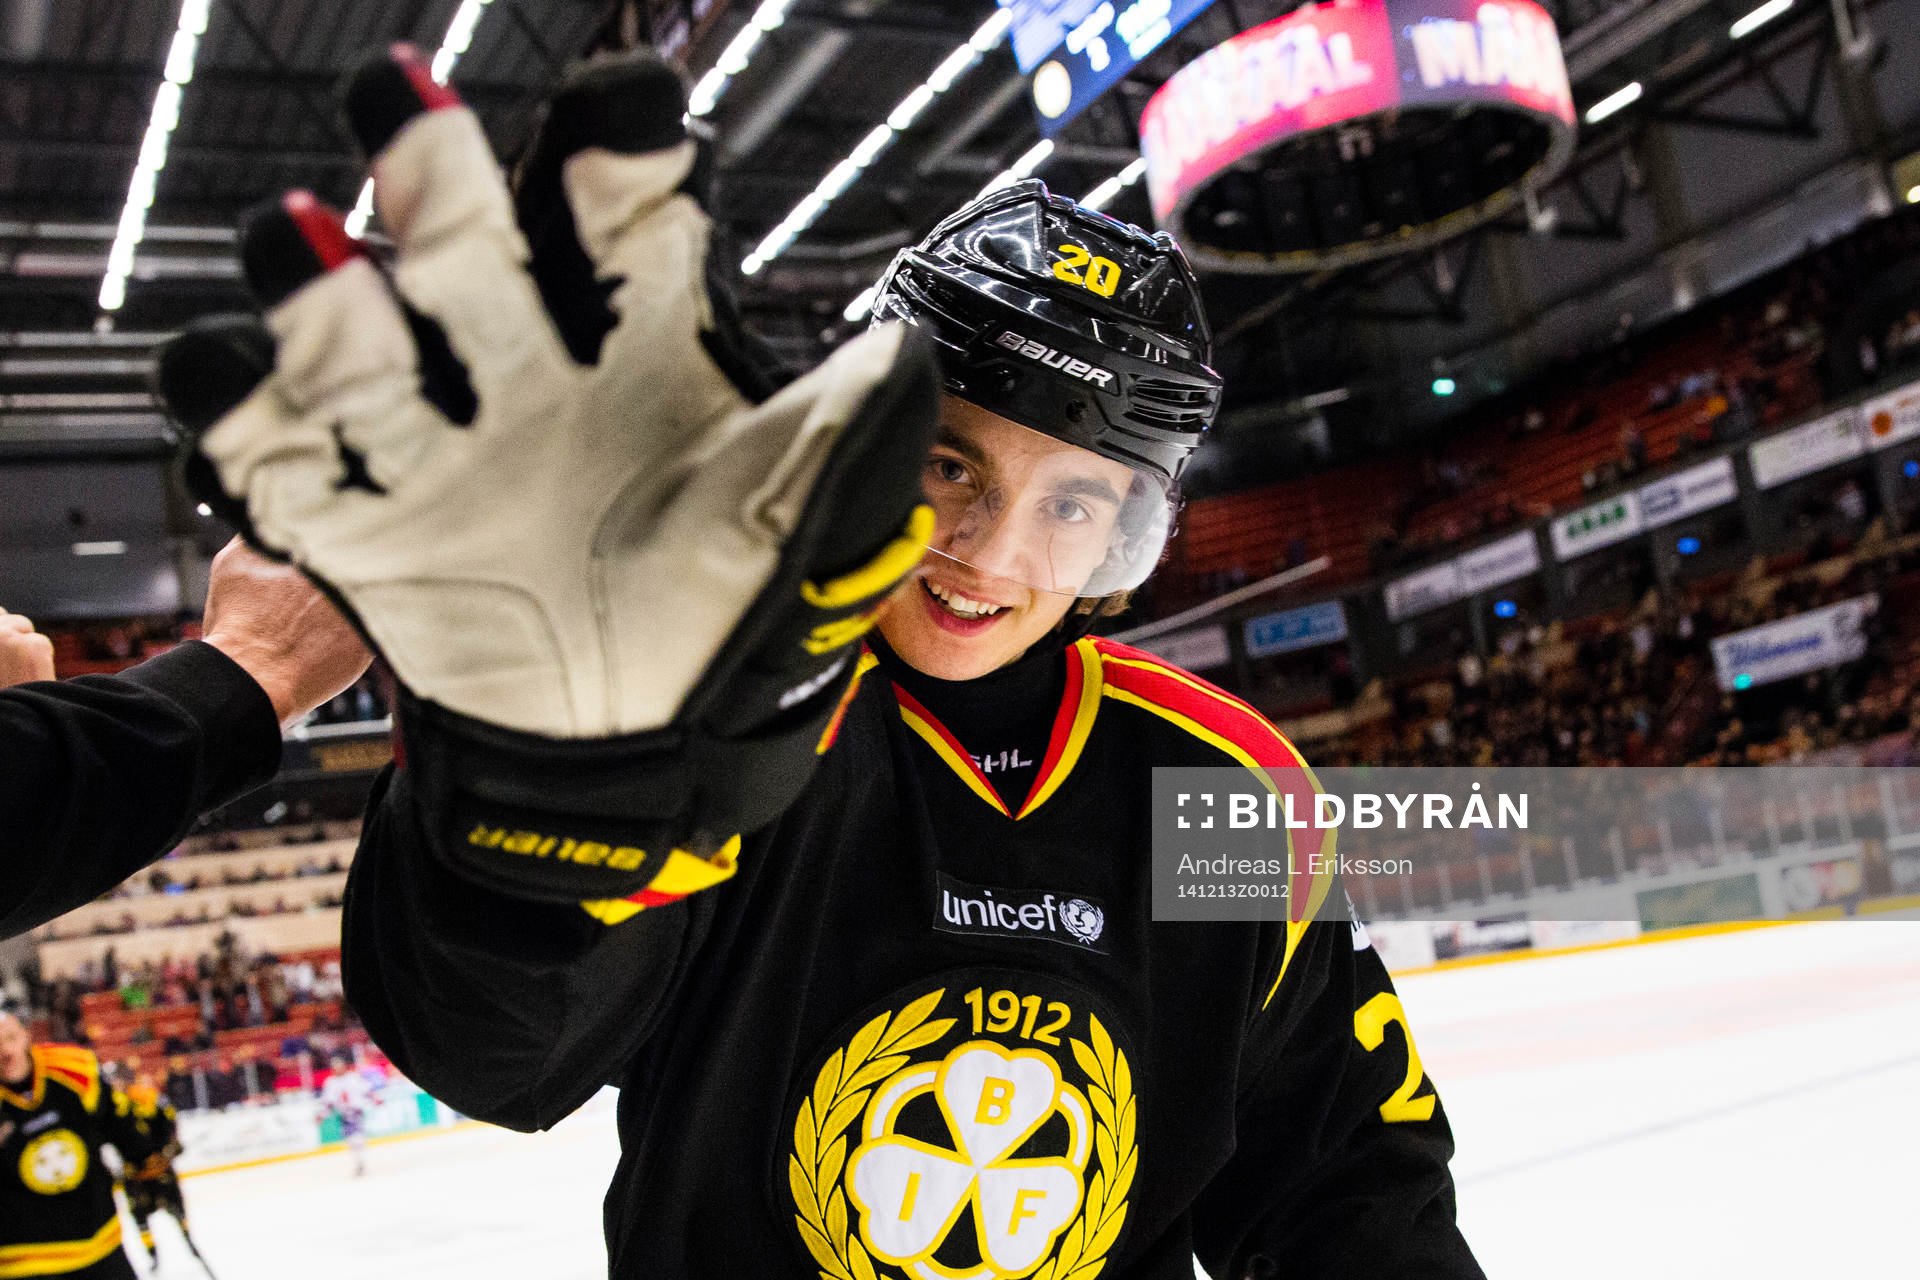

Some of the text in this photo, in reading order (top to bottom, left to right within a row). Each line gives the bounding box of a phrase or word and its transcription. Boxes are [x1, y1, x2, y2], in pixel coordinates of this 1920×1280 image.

[1053, 244, 1122, 298] 20
[997, 331, 1114, 388] BAUER
[943, 890, 1056, 932] unicef
[965, 987, 1071, 1046] 1912
[974, 1076, 1016, 1126] B
[898, 1172, 1048, 1236] I F
